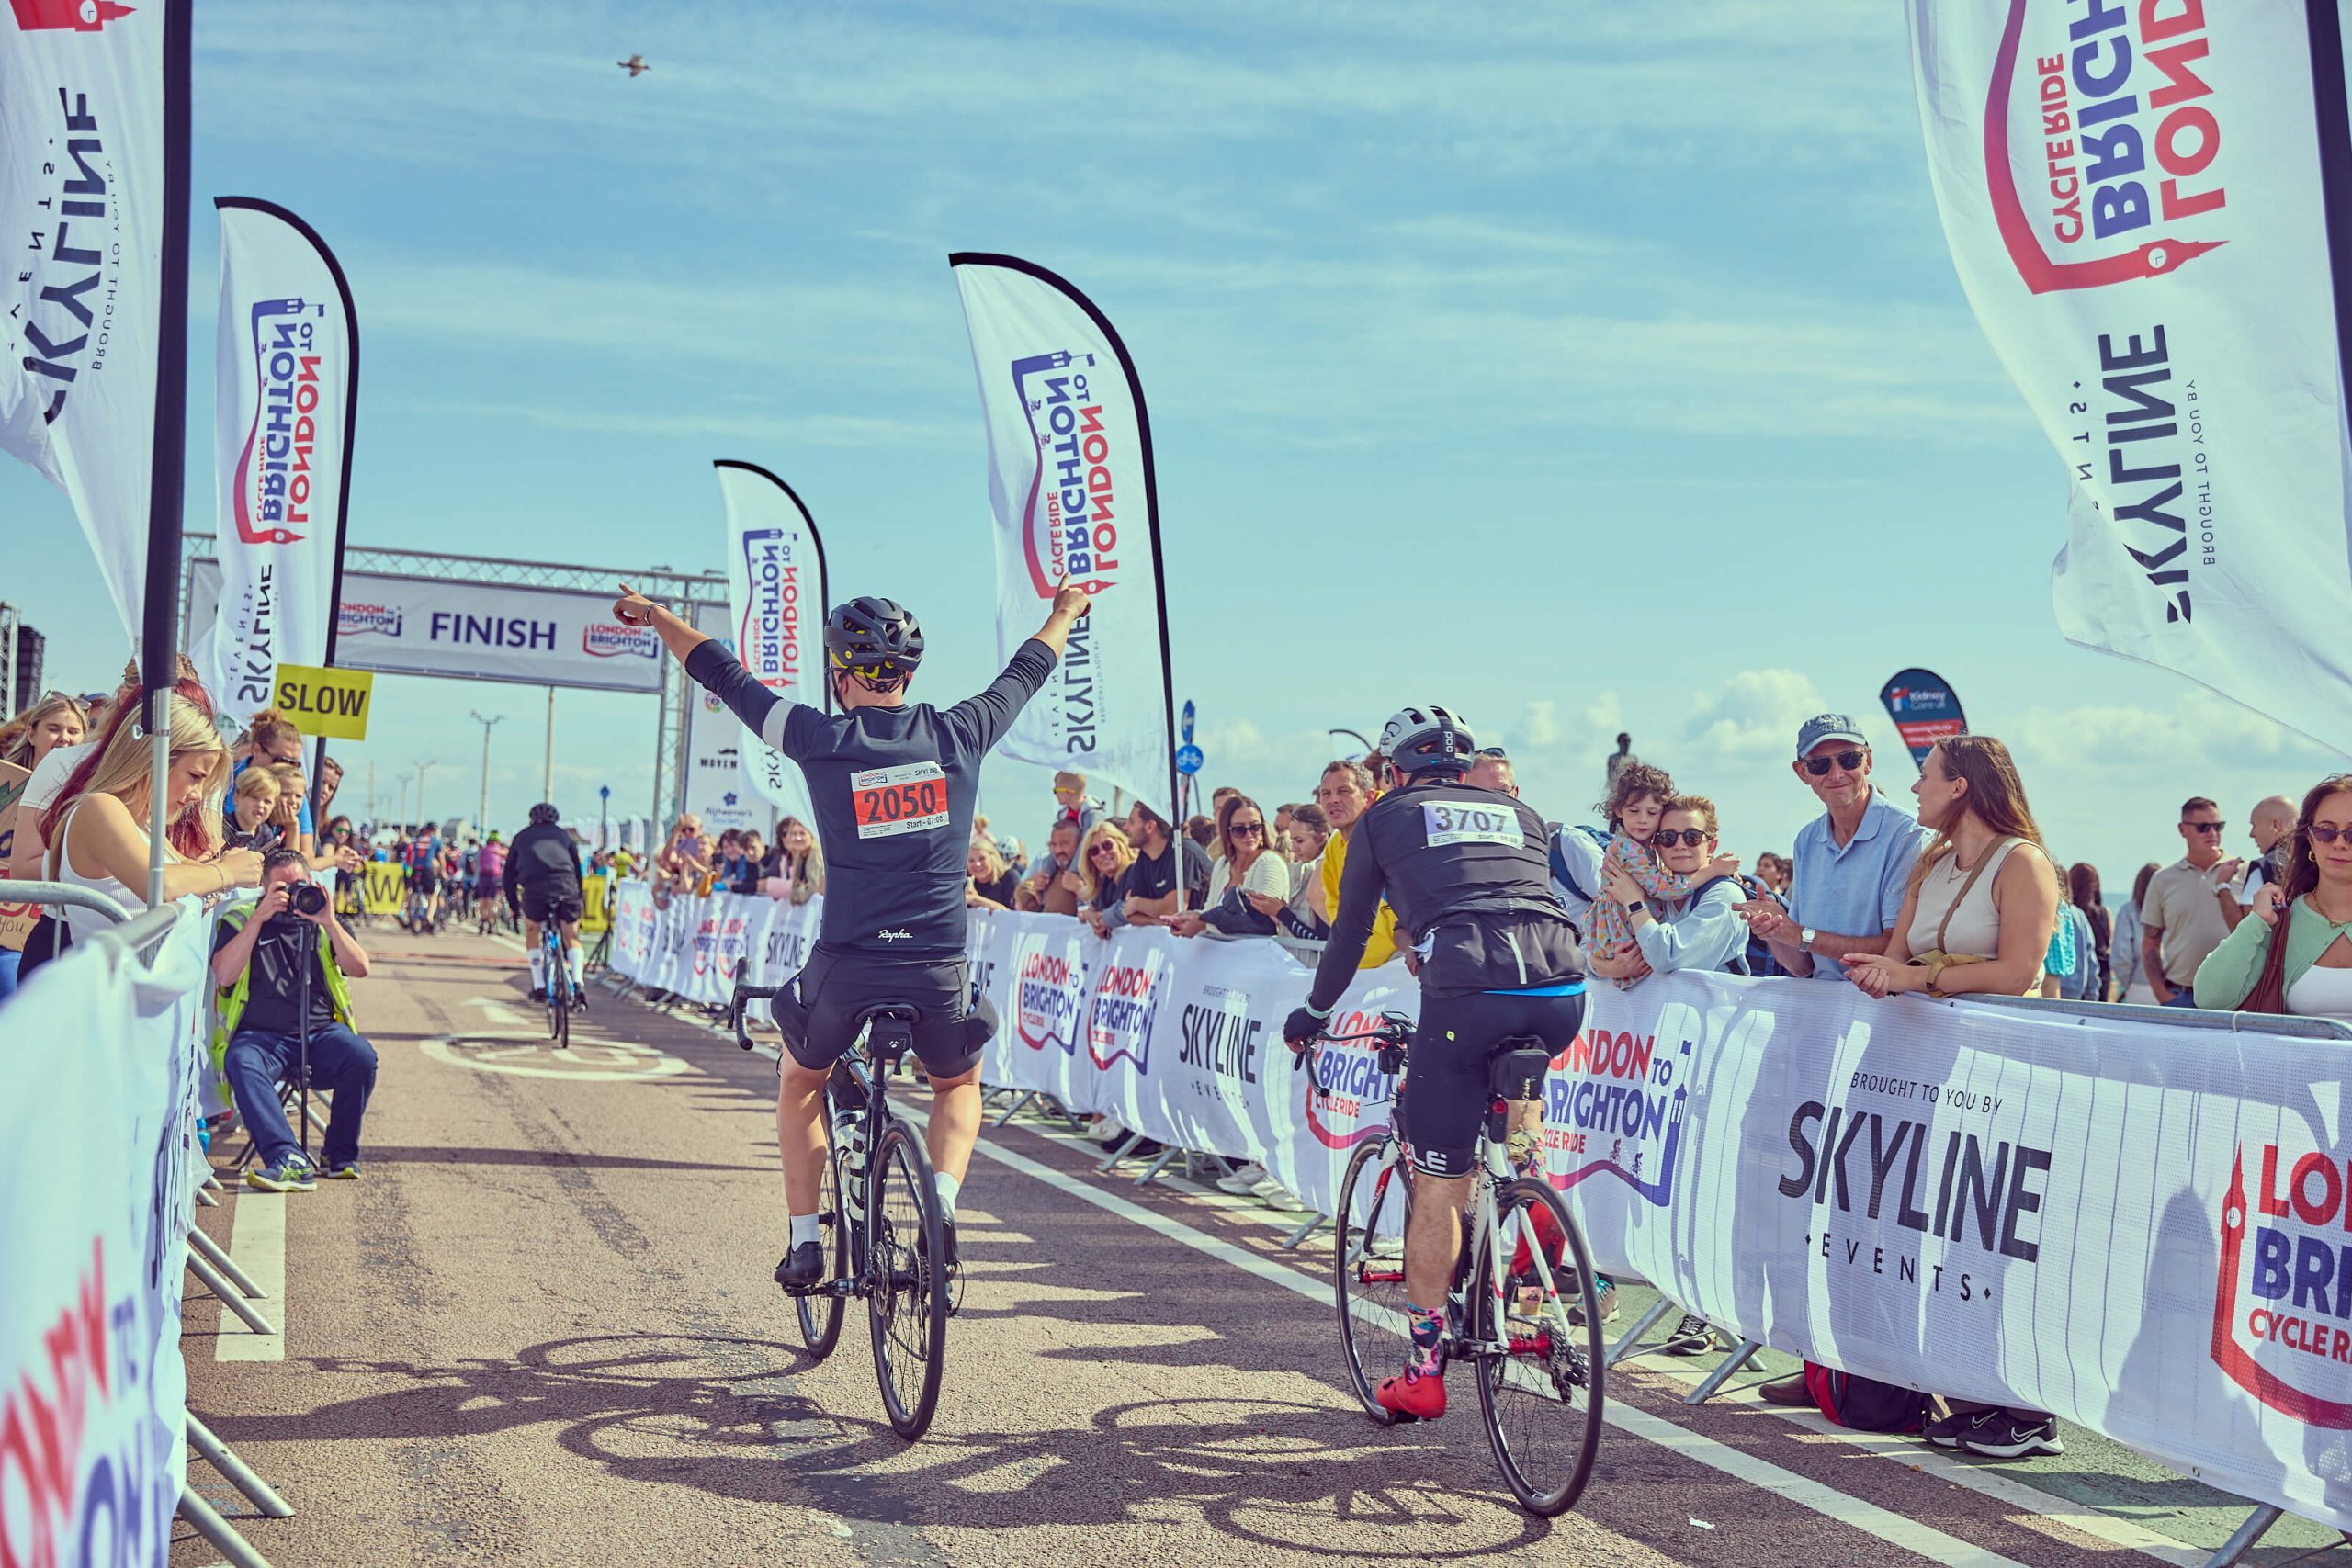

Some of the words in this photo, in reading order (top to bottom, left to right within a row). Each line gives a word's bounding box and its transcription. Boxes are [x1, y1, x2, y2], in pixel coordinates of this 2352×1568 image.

[339, 603, 385, 615] ONDON
[339, 614, 394, 625] RIGHTON
[431, 612, 557, 650] FINISH
[591, 624, 641, 636] LONDON
[278, 682, 367, 717] SLOW
[865, 783, 935, 822] 2050
[1435, 807, 1507, 831] 3707
[906, 820, 922, 829] Start
[1025, 953, 1069, 986] LONDON
[1069, 974, 1079, 987] TO
[1099, 965, 1154, 998] LONDON
[1023, 983, 1076, 1020] BRIGHTON
[1093, 998, 1151, 1035] BRIGHTON
[1180, 1003, 1261, 1084] SKYLINE
[1549, 1029, 1655, 1081] NDON
[1651, 1057, 1673, 1086] TO
[1319, 1051, 1394, 1100] BRIGH
[1850, 1071, 1917, 1099] BROUGHT
[1922, 1084, 1939, 1102] TO
[1946, 1089, 1977, 1110] YOU
[1981, 1096, 2003, 1115] BY
[1340, 1098, 1360, 1118] RIDE
[1562, 1131, 1586, 1154] RIDE
[1778, 1100, 2052, 1263] SKYLINE
[2258, 1144, 2352, 1233] LO
[1822, 1233, 1971, 1302] EVENTS
[2248, 1307, 2329, 1357] CYCLE
